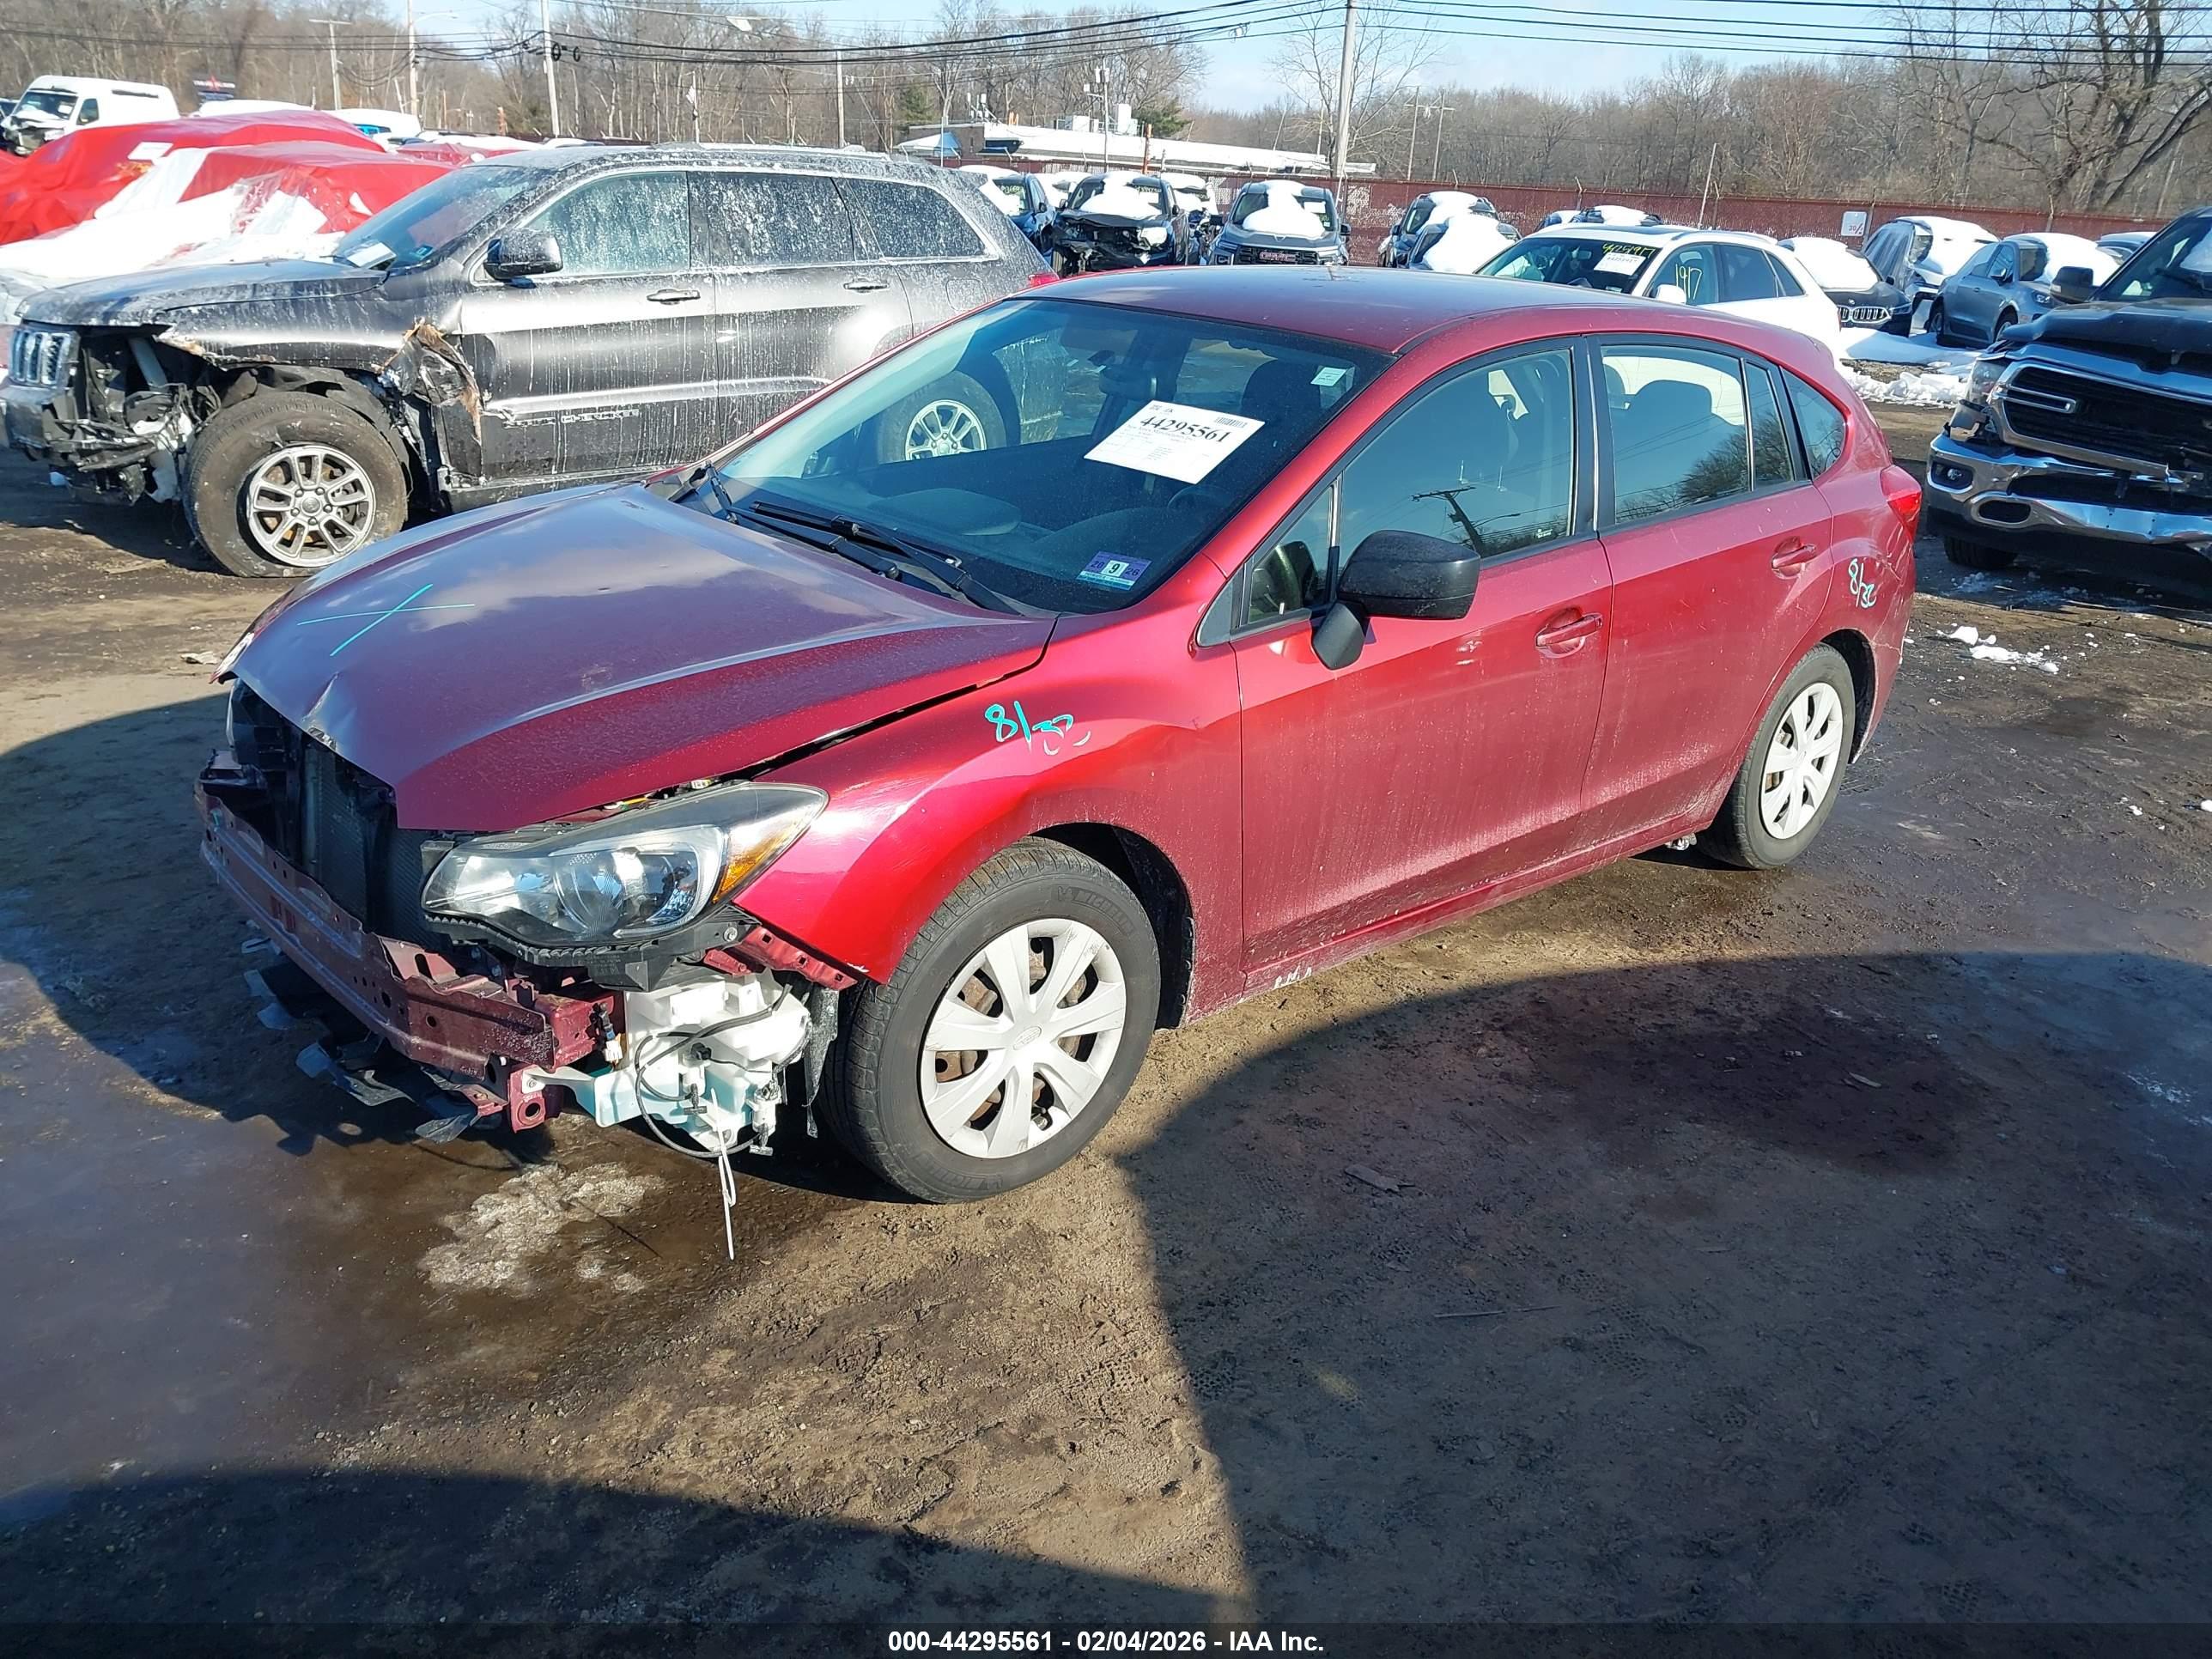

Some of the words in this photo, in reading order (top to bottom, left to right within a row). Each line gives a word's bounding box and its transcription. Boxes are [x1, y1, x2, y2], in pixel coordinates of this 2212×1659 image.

[1675, 263, 1703, 300] 1917
[1139, 416, 1231, 443] 44295561
[1109, 563, 1120, 574] 9
[1126, 568, 1139, 576] 26
